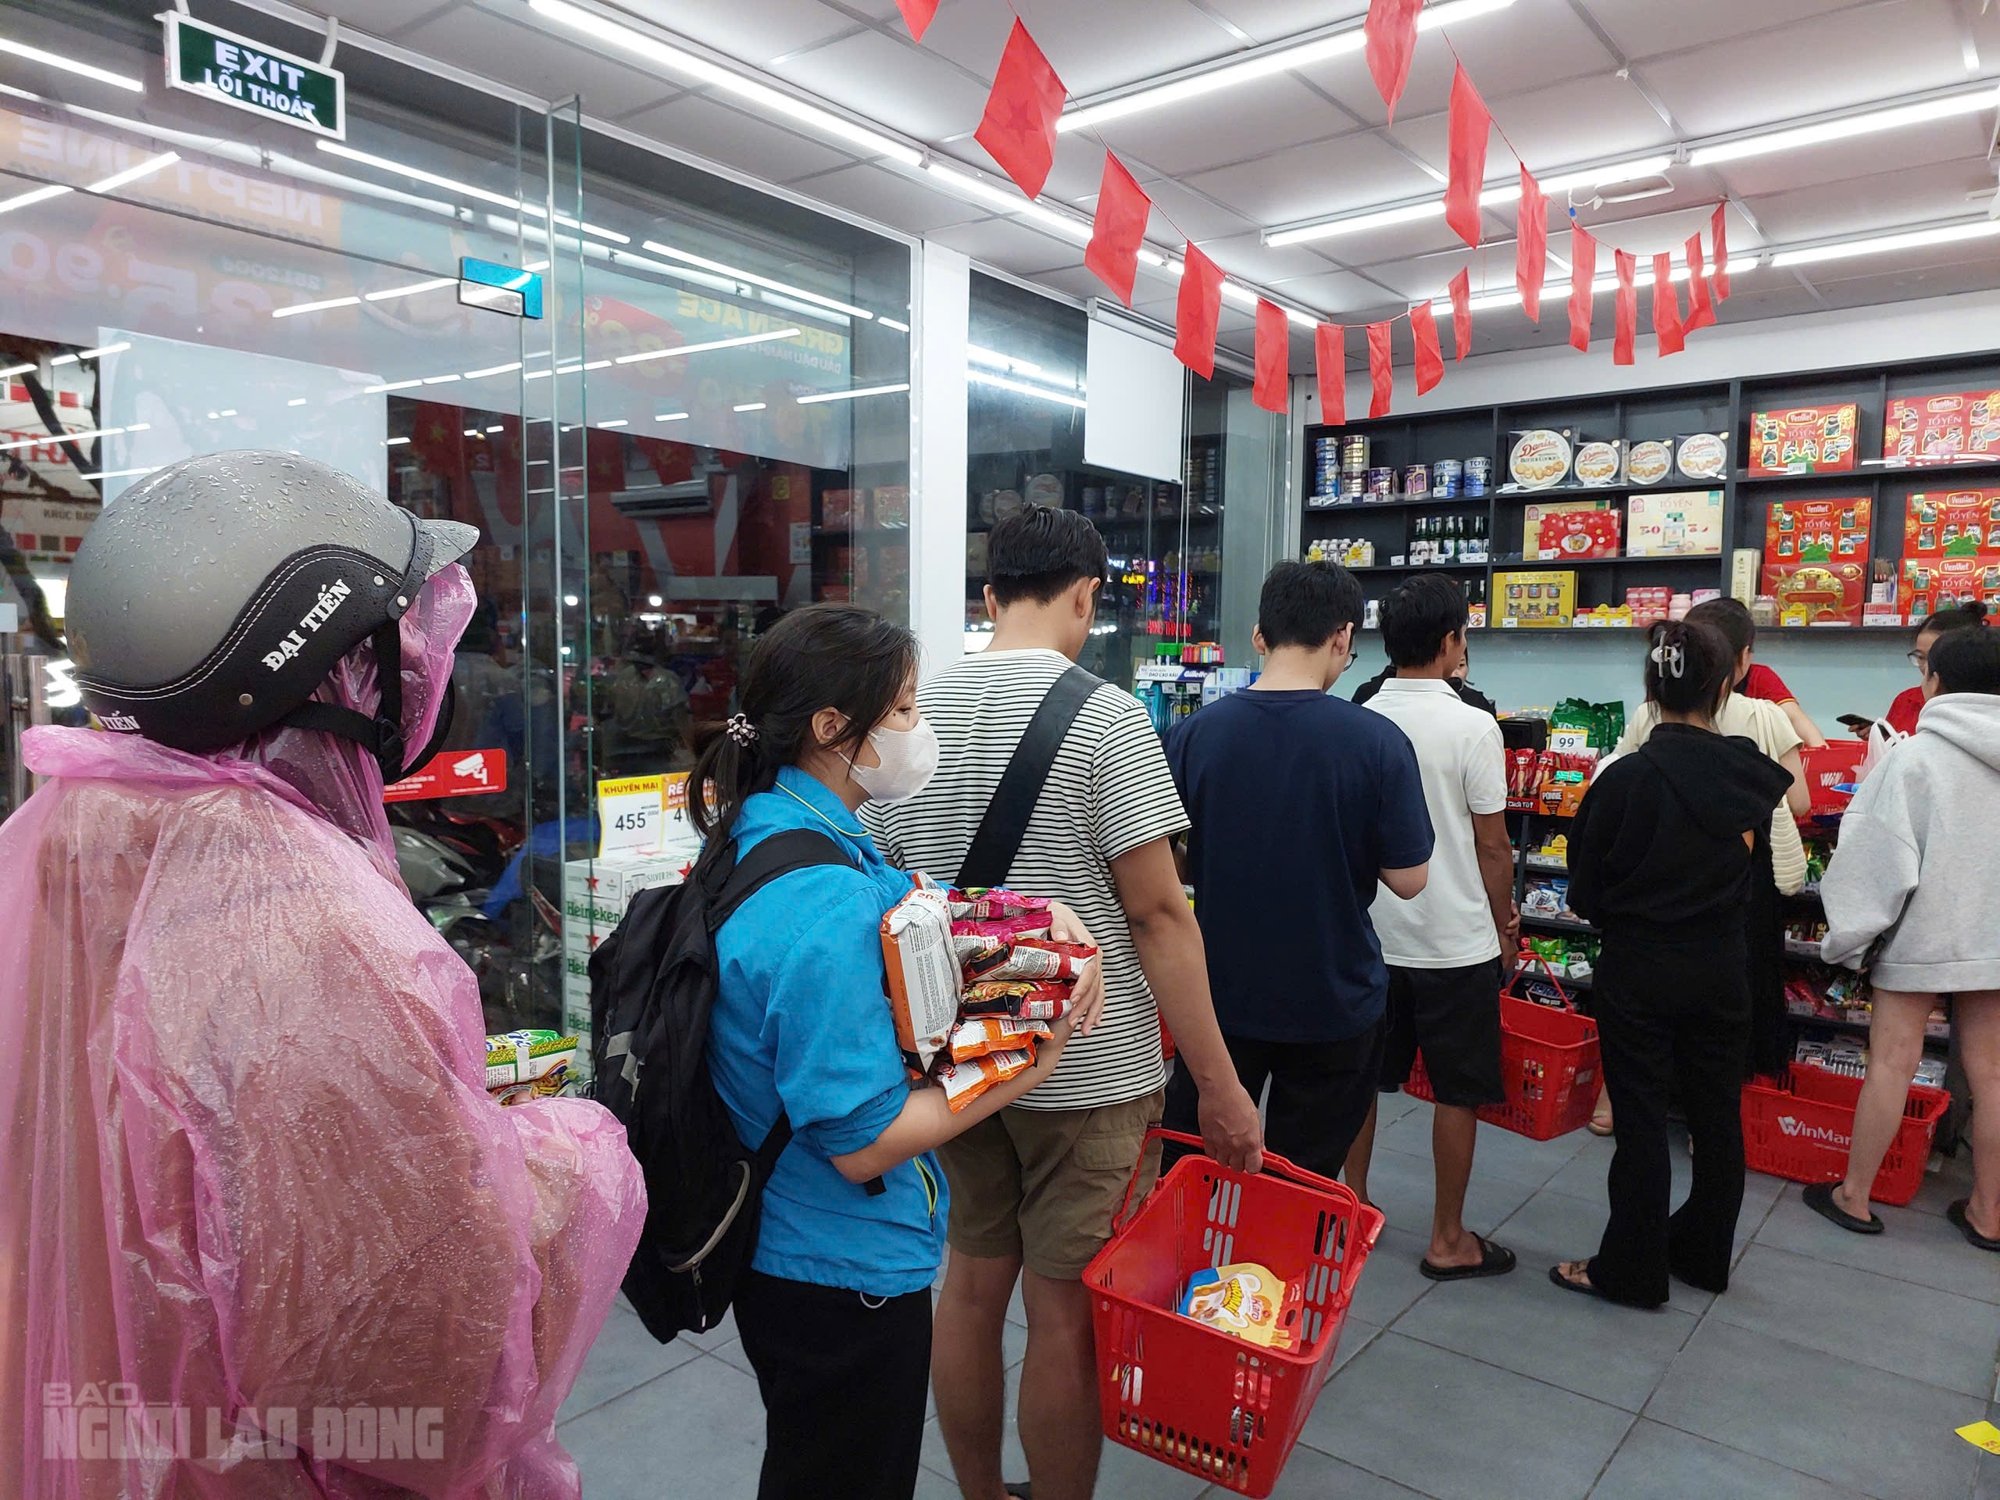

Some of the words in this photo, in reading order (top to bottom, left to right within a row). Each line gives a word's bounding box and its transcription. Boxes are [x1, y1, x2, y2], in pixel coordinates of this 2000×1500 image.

[215, 40, 305, 91] EXIT
[204, 67, 242, 97] LỐI
[248, 82, 316, 118] THOÁT
[261, 630, 308, 672] ĐẠI
[300, 578, 352, 633] TIẾN
[1559, 737, 1574, 748] 99
[615, 812, 647, 831] 455
[1777, 1115, 1851, 1147] WinMar
